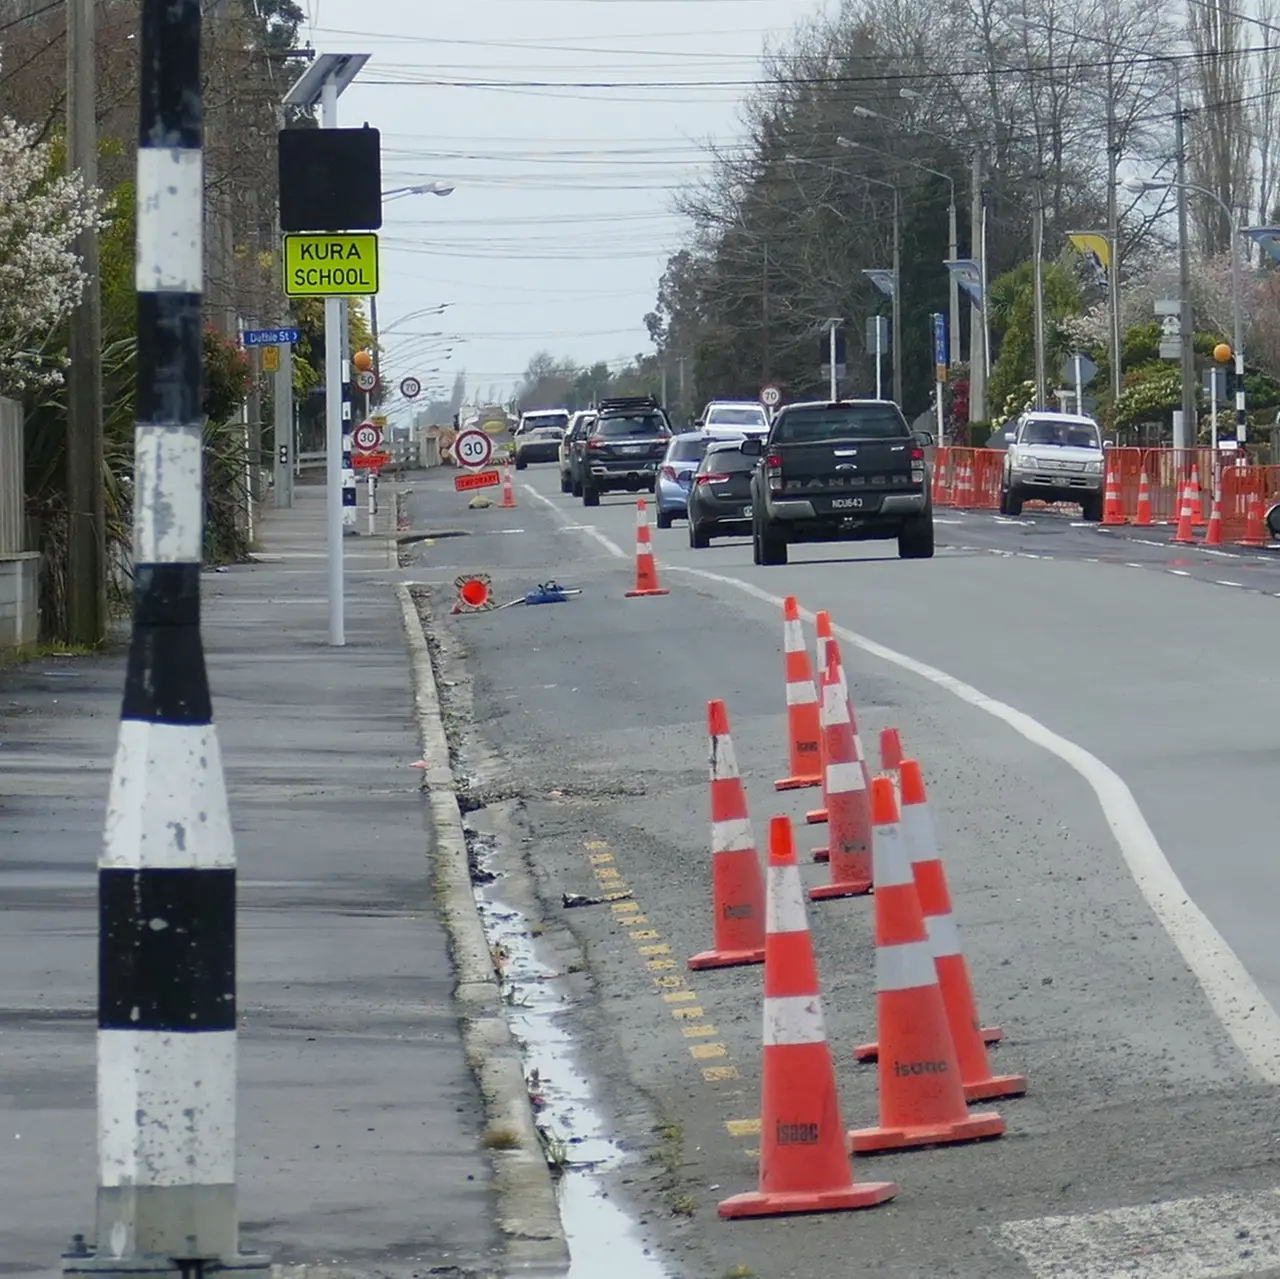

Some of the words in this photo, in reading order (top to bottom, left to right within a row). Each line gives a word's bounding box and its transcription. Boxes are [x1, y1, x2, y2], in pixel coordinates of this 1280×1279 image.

[301, 243, 362, 260] KURA
[295, 268, 369, 286] SCHOOL
[279, 331, 290, 342] St
[360, 375, 373, 386] 50
[405, 383, 417, 392] 70
[764, 391, 778, 401] 70
[360, 432, 375, 443] 30
[464, 441, 484, 457] 30
[895, 1061, 948, 1078] isaac
[776, 1119, 818, 1144] isaac
